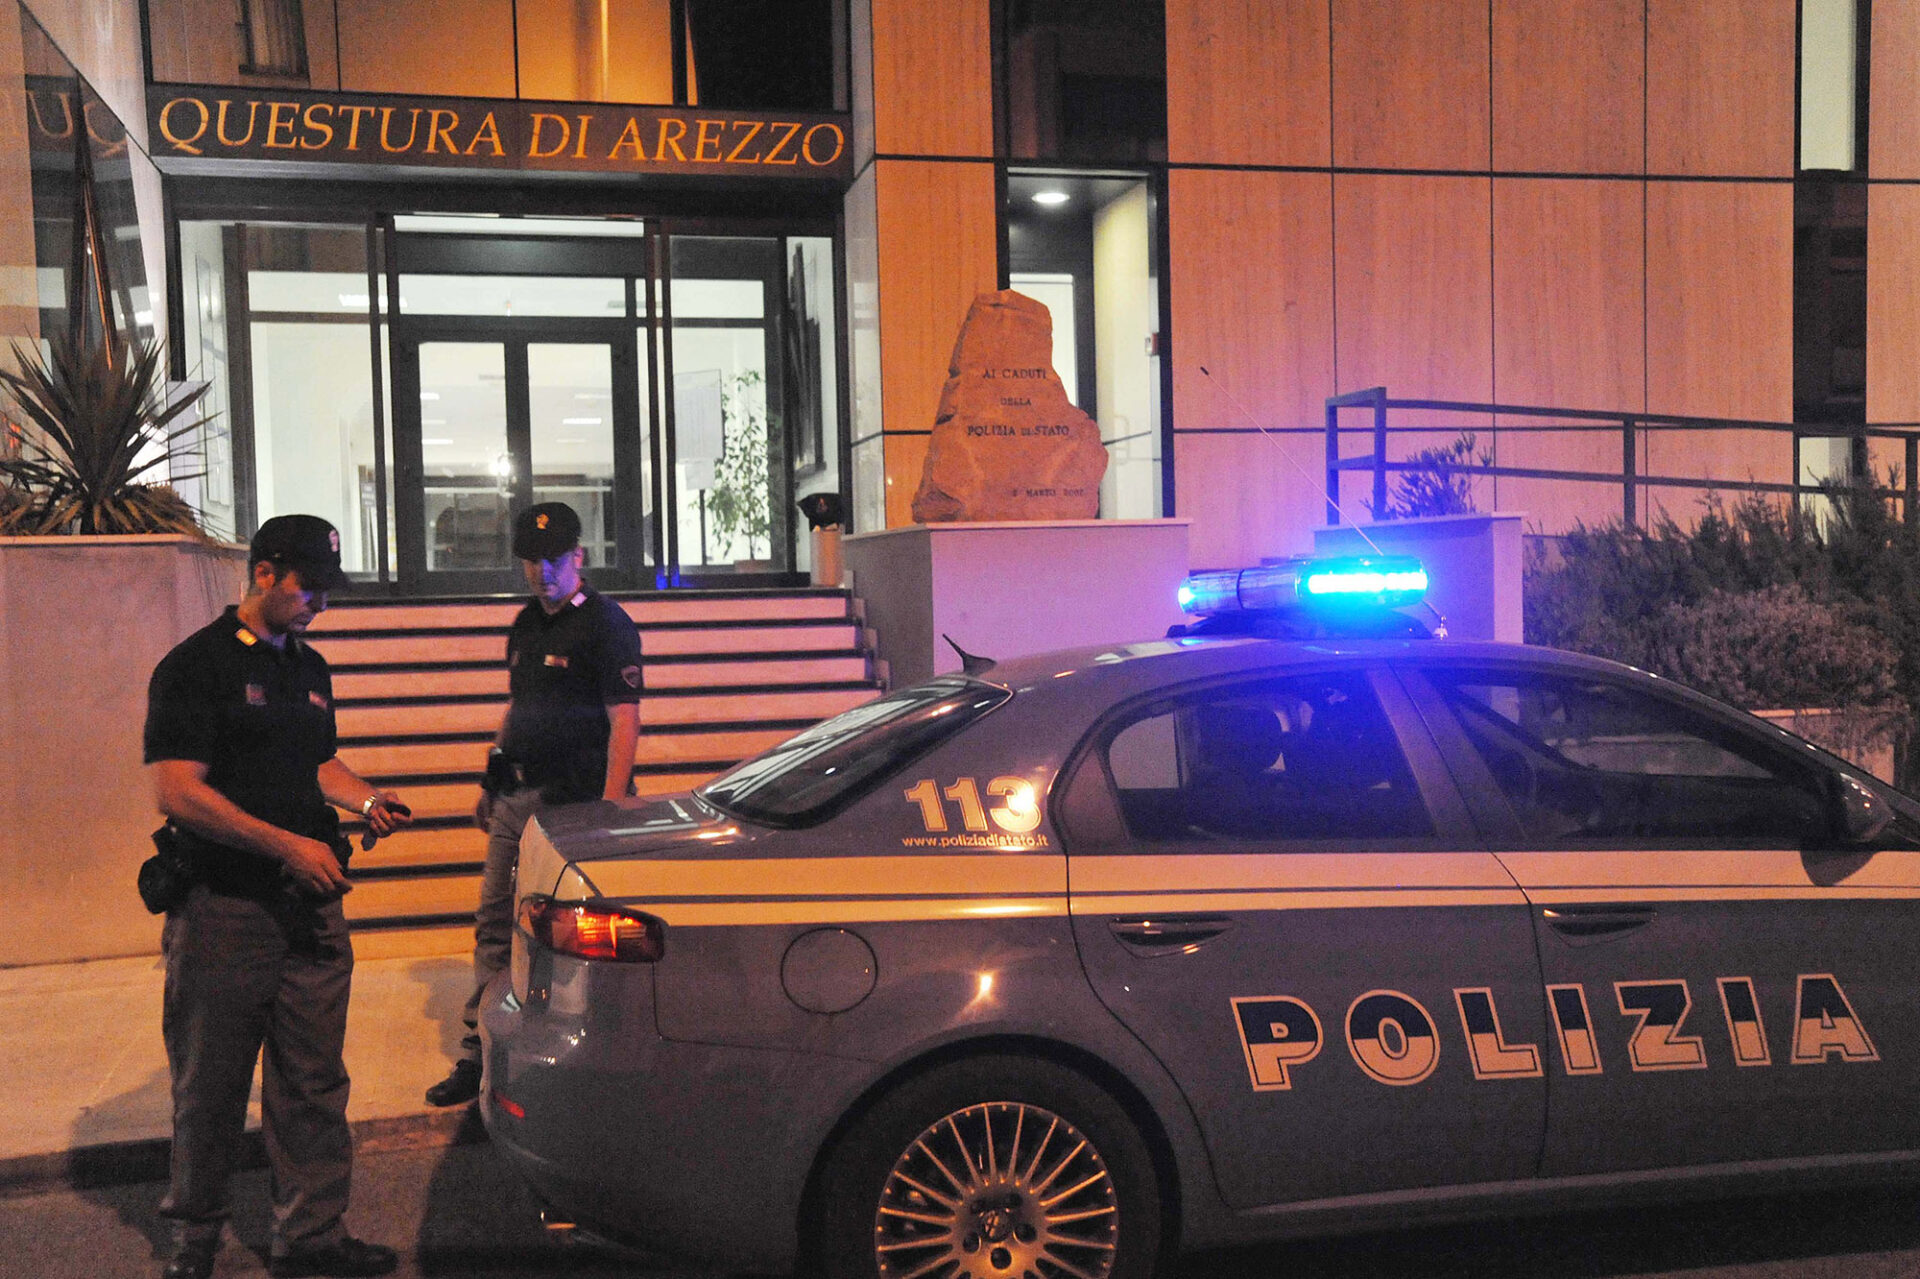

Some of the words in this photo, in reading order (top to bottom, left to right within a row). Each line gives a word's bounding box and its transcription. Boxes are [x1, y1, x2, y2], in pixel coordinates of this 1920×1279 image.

[158, 97, 506, 156] QUESTURA
[528, 113, 593, 159] DI
[606, 116, 845, 167] AREZZO
[982, 368, 996, 379] AI
[1002, 368, 1047, 380] CADUTI
[1000, 398, 1032, 406] DELLA
[967, 426, 1016, 436] POLIZIA
[1034, 426, 1070, 436] STATO
[904, 776, 1041, 832] 113
[902, 834, 1048, 848] www.poliziadistato.it
[1229, 973, 1880, 1092] POLIZIA
